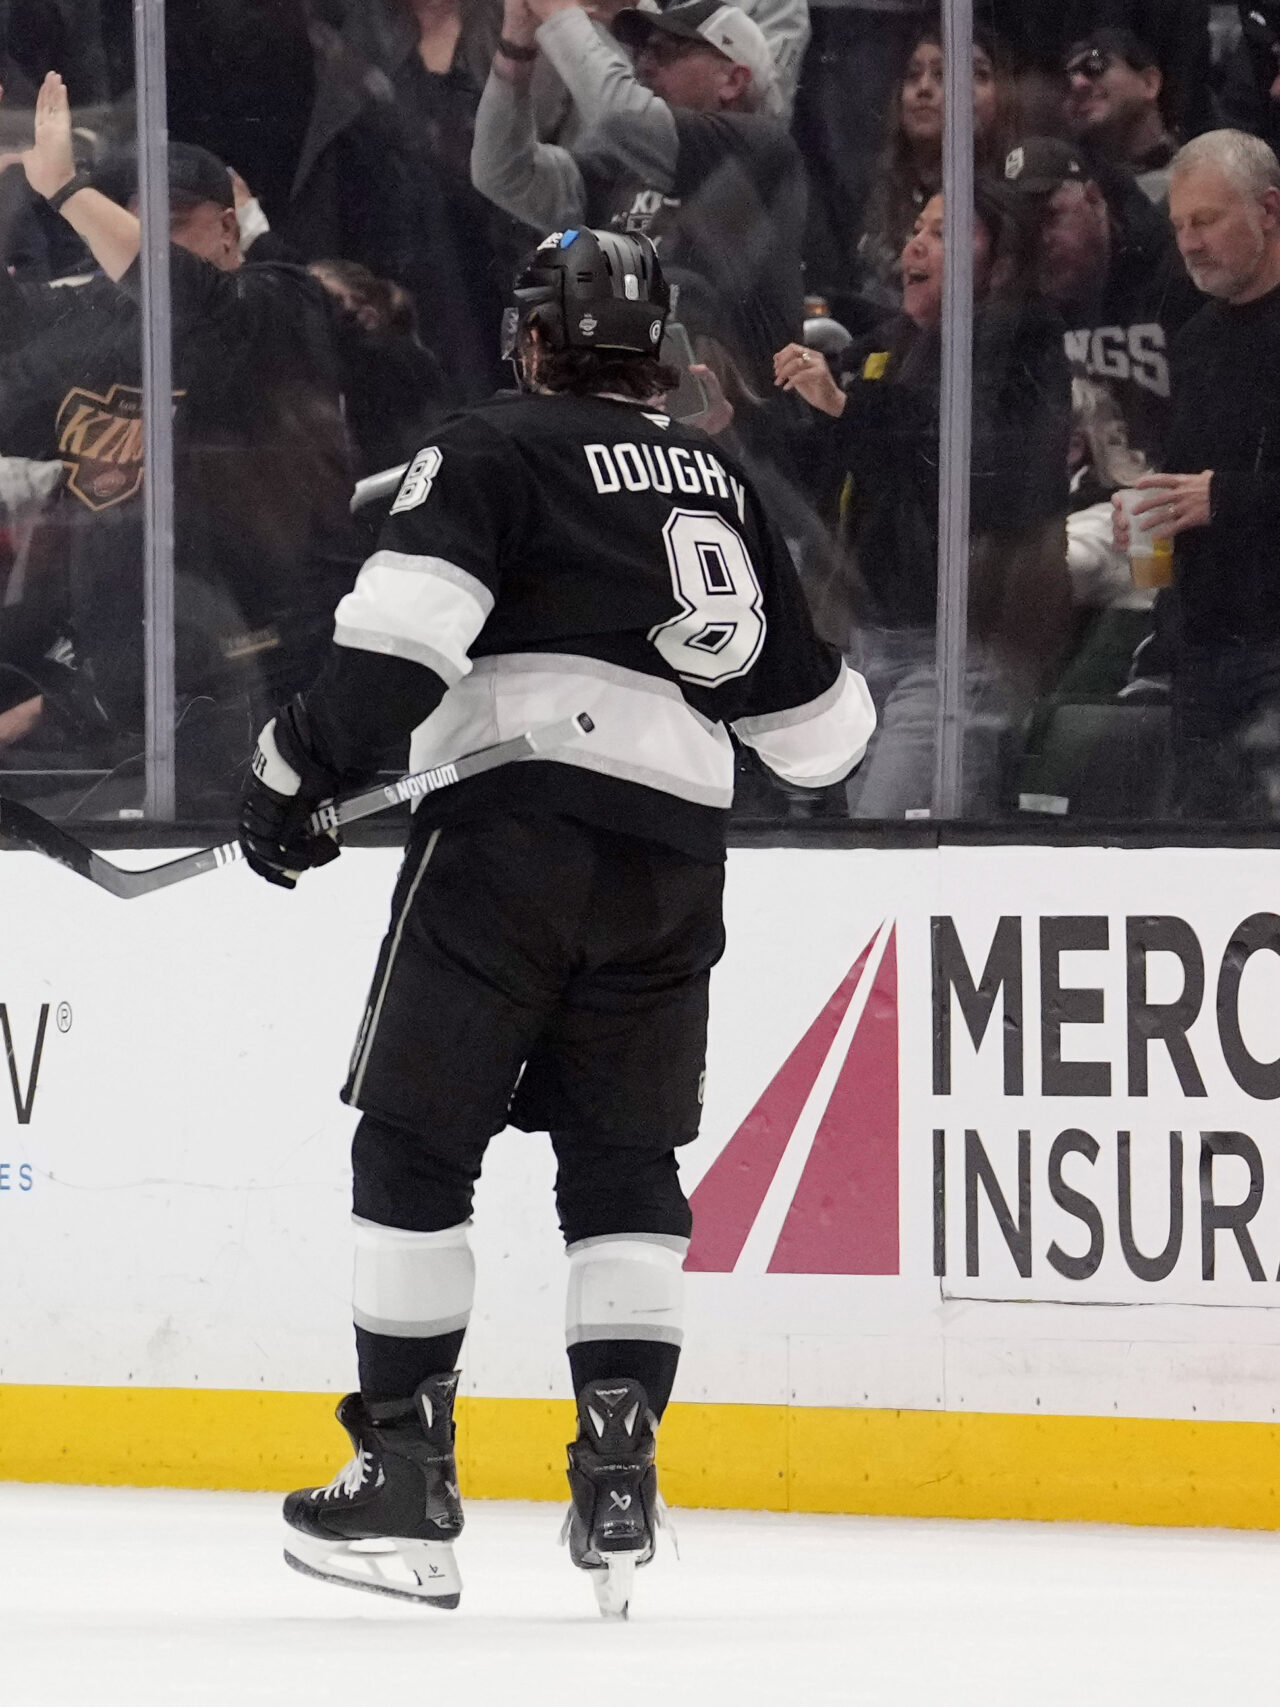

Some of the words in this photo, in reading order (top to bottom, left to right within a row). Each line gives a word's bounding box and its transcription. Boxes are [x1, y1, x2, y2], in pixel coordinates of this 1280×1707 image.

[389, 445, 443, 516] 8
[583, 442, 745, 525] DOUGHY
[646, 507, 767, 689] 8
[395, 763, 459, 801] NOVIUM
[930, 911, 1280, 1101] MERC
[932, 1128, 1280, 1282] INSUR
